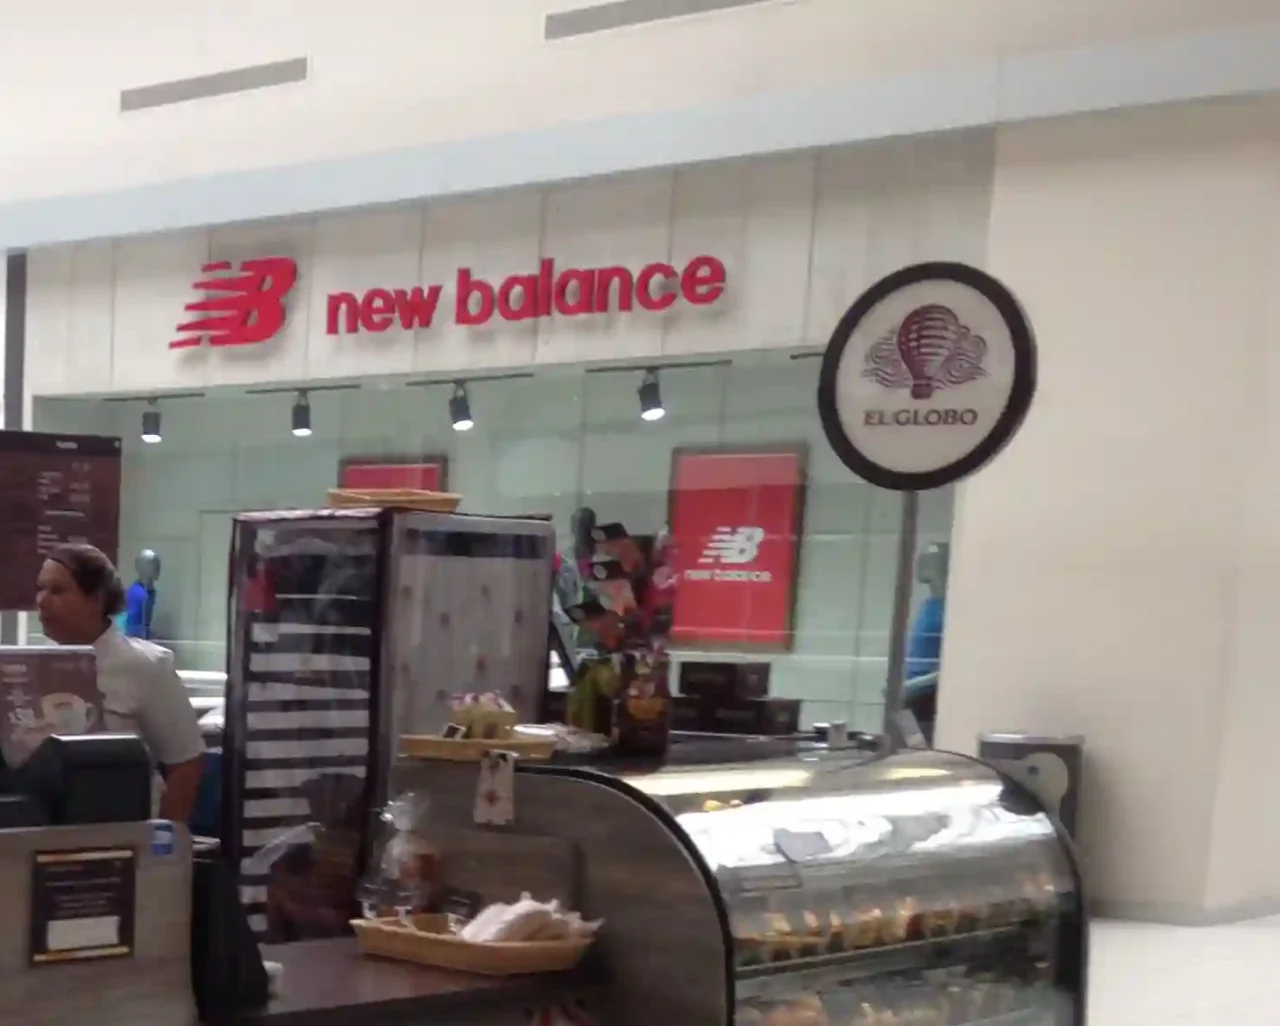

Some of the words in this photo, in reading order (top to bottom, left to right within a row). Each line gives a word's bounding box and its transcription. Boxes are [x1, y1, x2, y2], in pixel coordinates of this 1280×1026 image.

[326, 284, 443, 335] new
[455, 254, 726, 327] balance
[863, 408, 894, 427] EL
[895, 407, 979, 427] GLOBO
